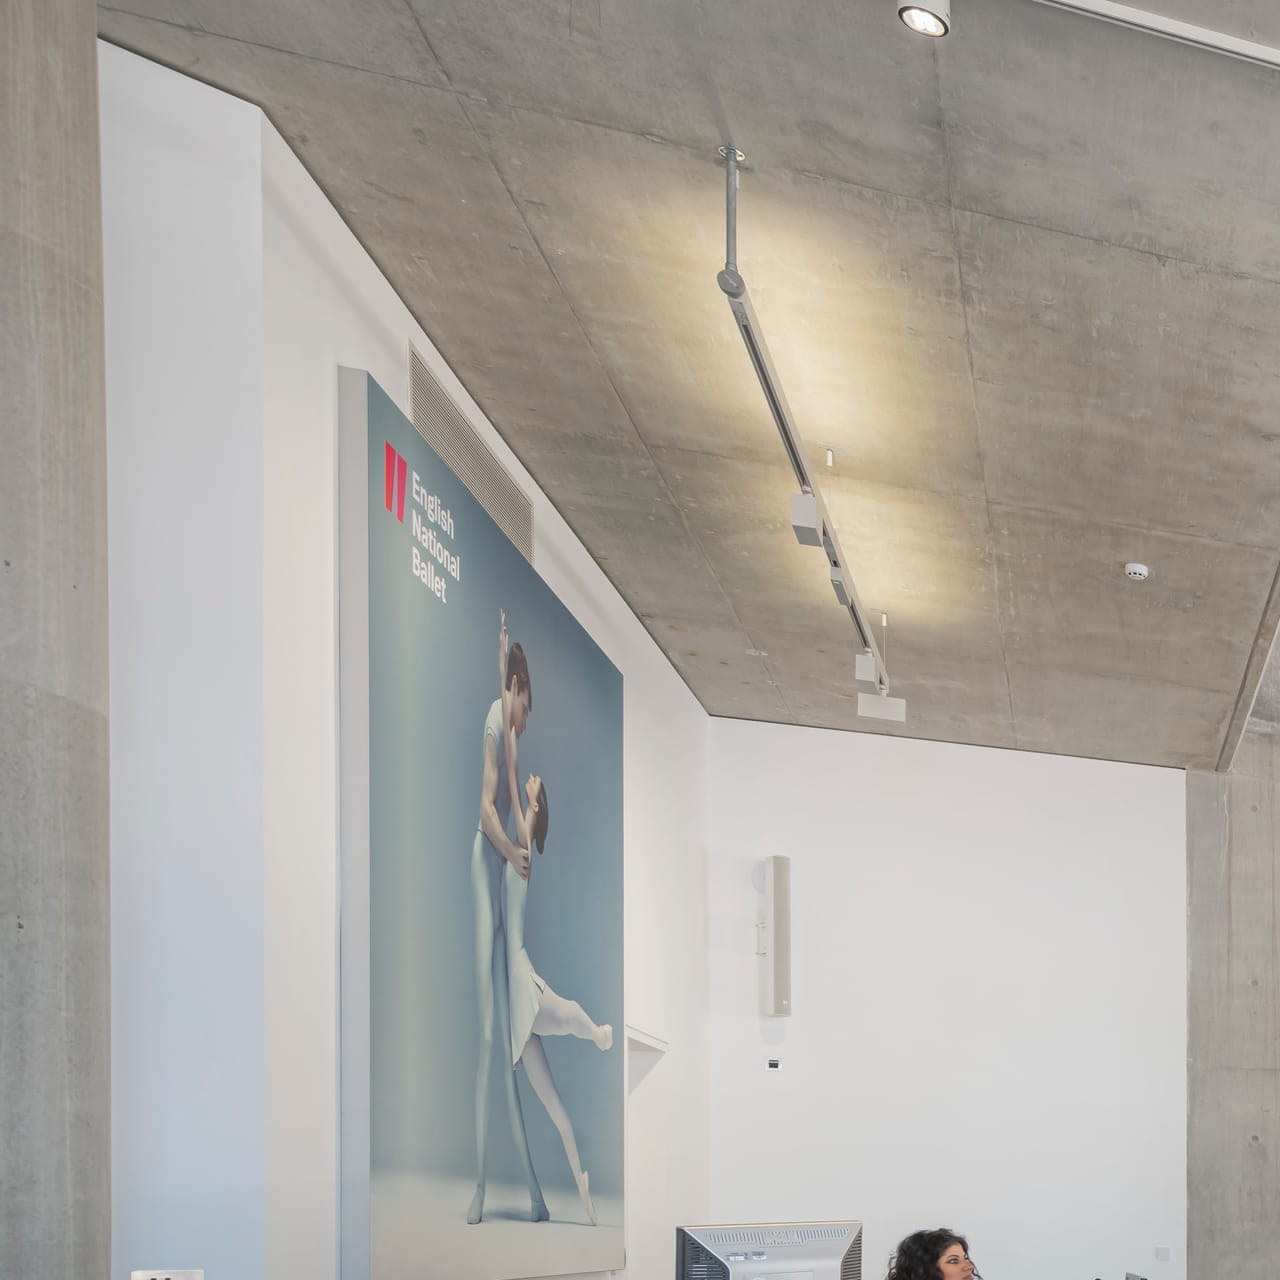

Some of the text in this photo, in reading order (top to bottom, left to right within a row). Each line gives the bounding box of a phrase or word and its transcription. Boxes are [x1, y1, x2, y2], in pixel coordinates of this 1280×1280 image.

[412, 470, 455, 540] English
[412, 508, 461, 582] National
[412, 547, 448, 604] Ballet
